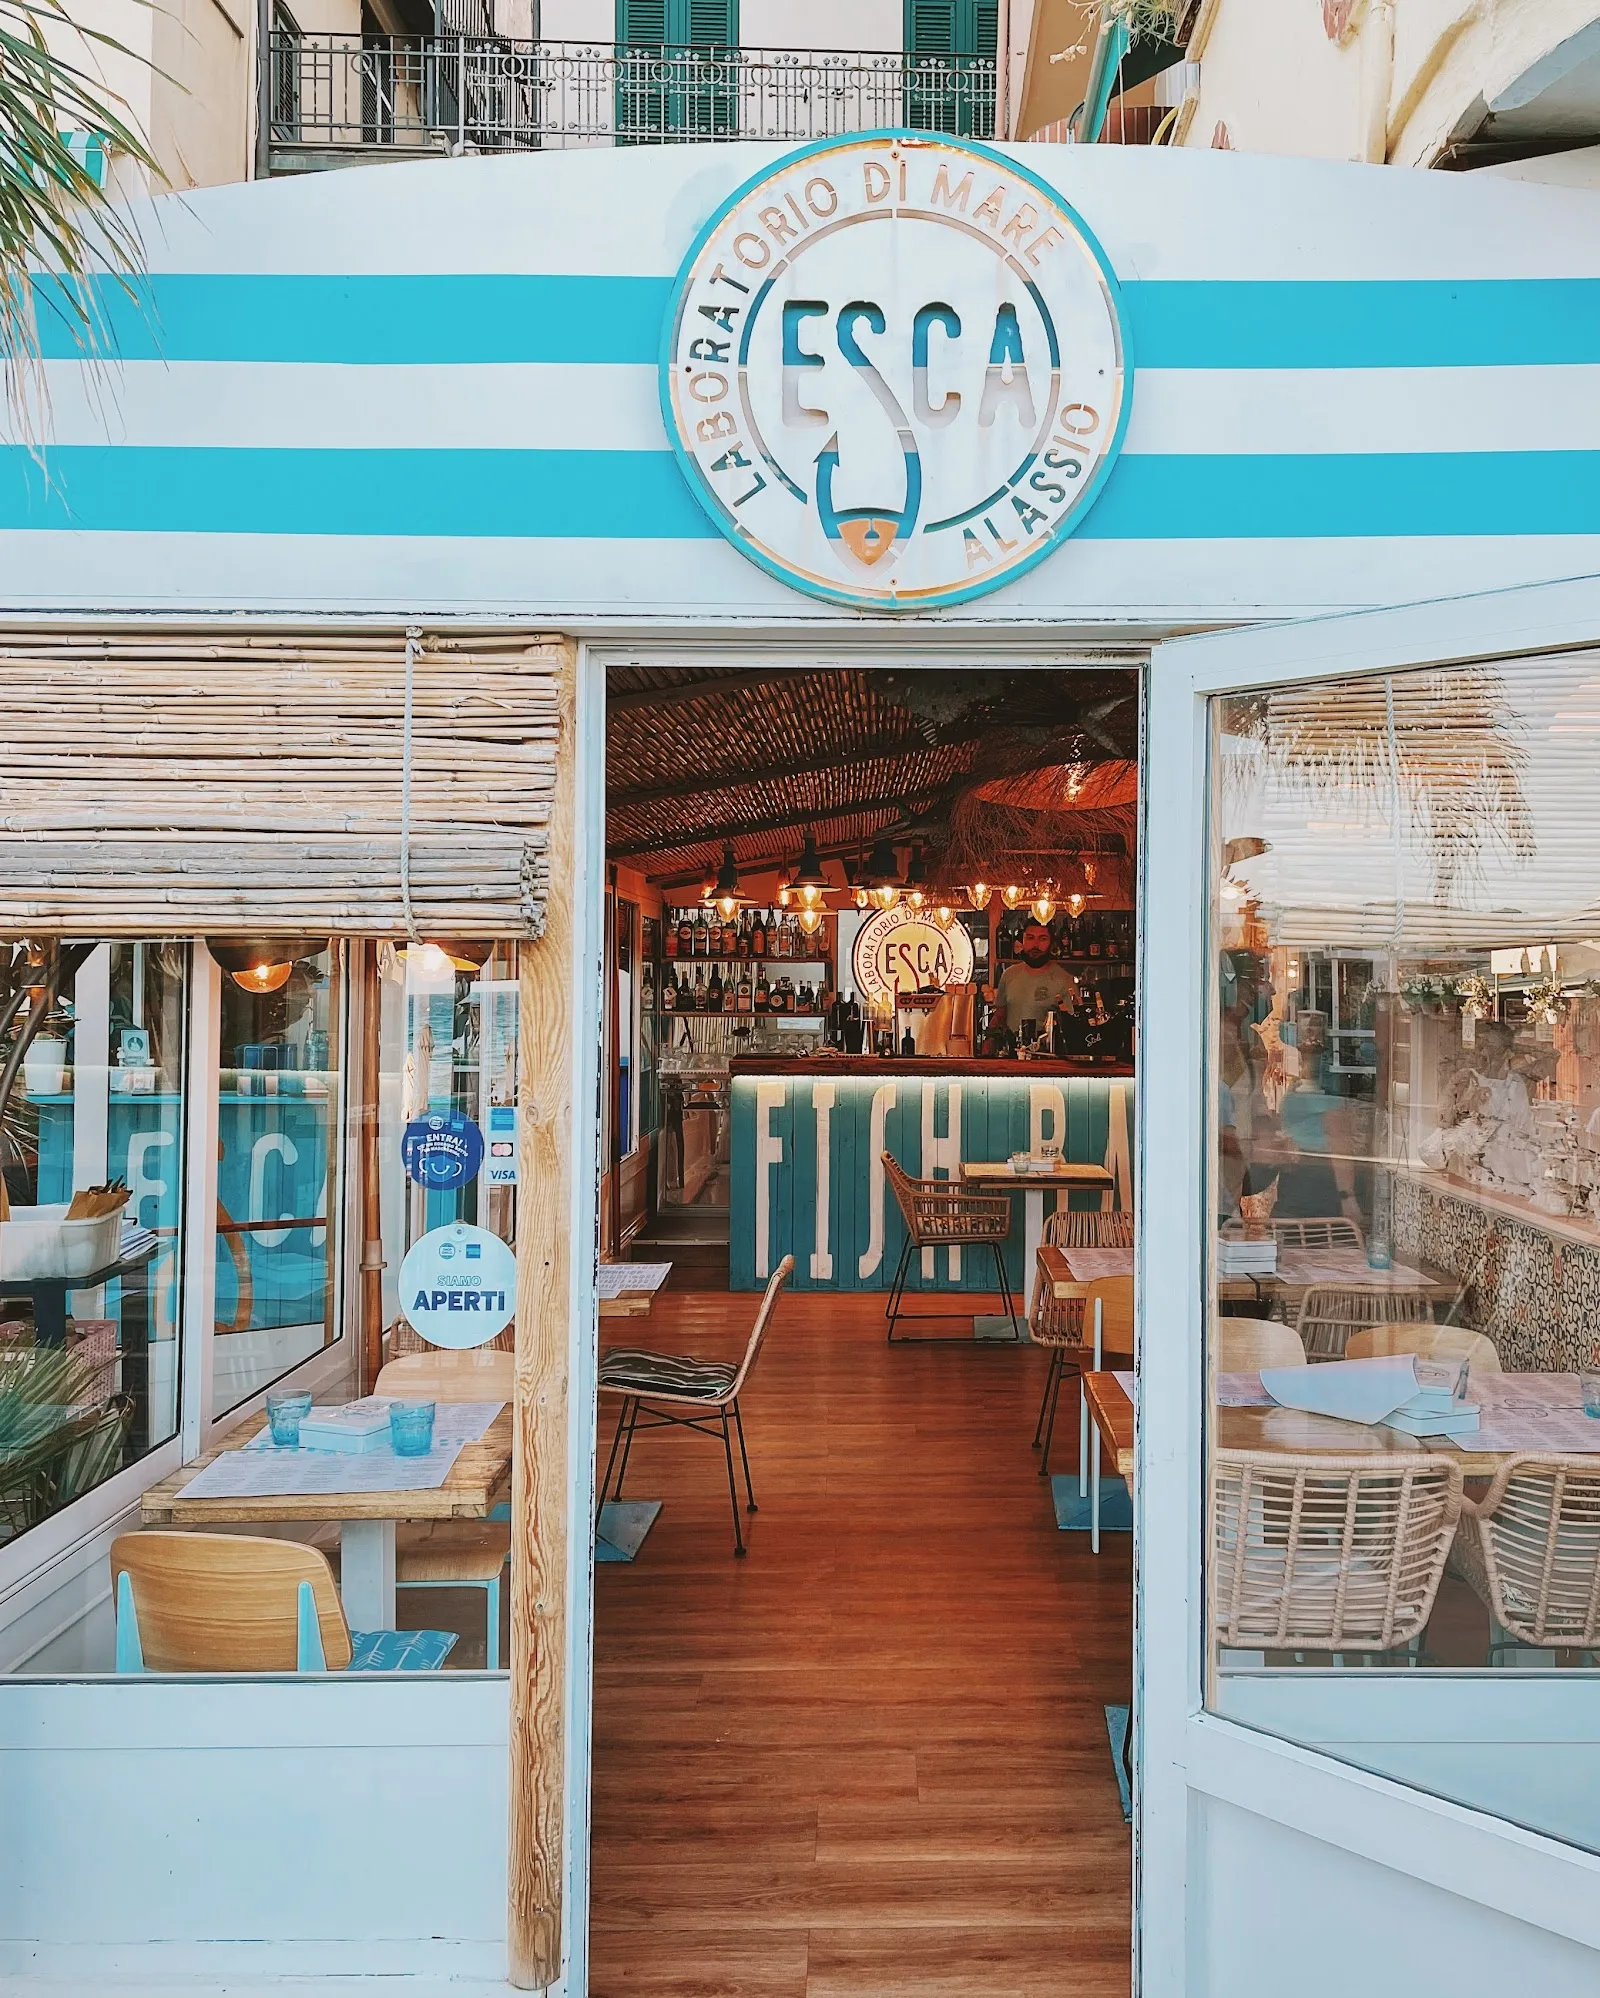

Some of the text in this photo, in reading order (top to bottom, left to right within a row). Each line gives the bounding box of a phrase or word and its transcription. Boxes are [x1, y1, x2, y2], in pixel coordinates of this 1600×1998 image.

[688, 159, 1065, 508] LABORATORIO DI MARE
[782, 299, 1037, 429] ESCA
[962, 403, 1100, 569] ALASSIO
[863, 913, 899, 993] LABORATORIO
[885, 943, 948, 974] ESCA
[426, 1133, 463, 1147] ENTRA!
[490, 1170, 516, 1180] VISA
[755, 1082, 962, 1281] FISH
[412, 1290, 505, 1311] APERTI
[437, 1275, 482, 1287] SIAMO
